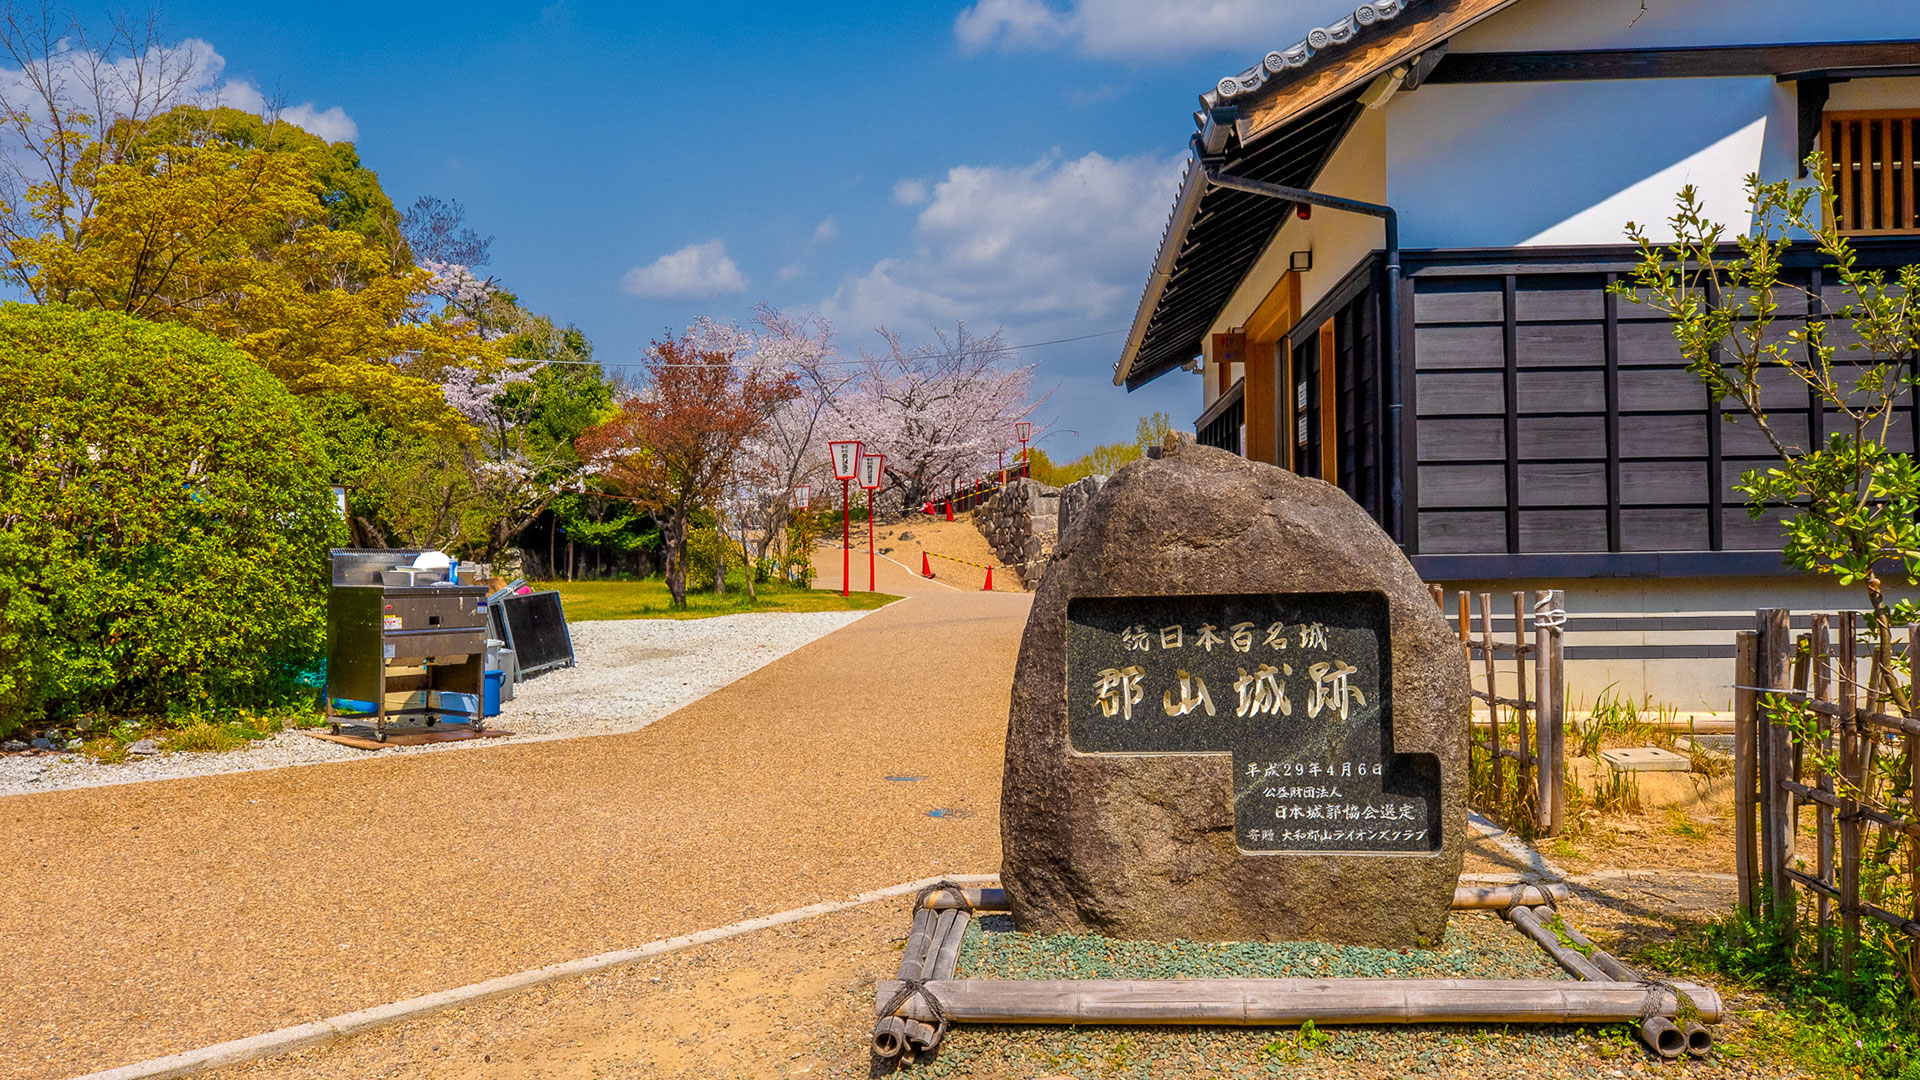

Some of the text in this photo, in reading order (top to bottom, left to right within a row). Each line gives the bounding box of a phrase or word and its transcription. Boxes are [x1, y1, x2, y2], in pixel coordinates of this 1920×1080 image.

[1121, 621, 1329, 652] 続日本百名城
[1094, 660, 1366, 720] 郡山城跡
[1245, 762, 1383, 777] 平成29年4月6日
[1262, 786, 1343, 798] 公益財団法人
[1275, 804, 1416, 820] 日本城郭協会選定
